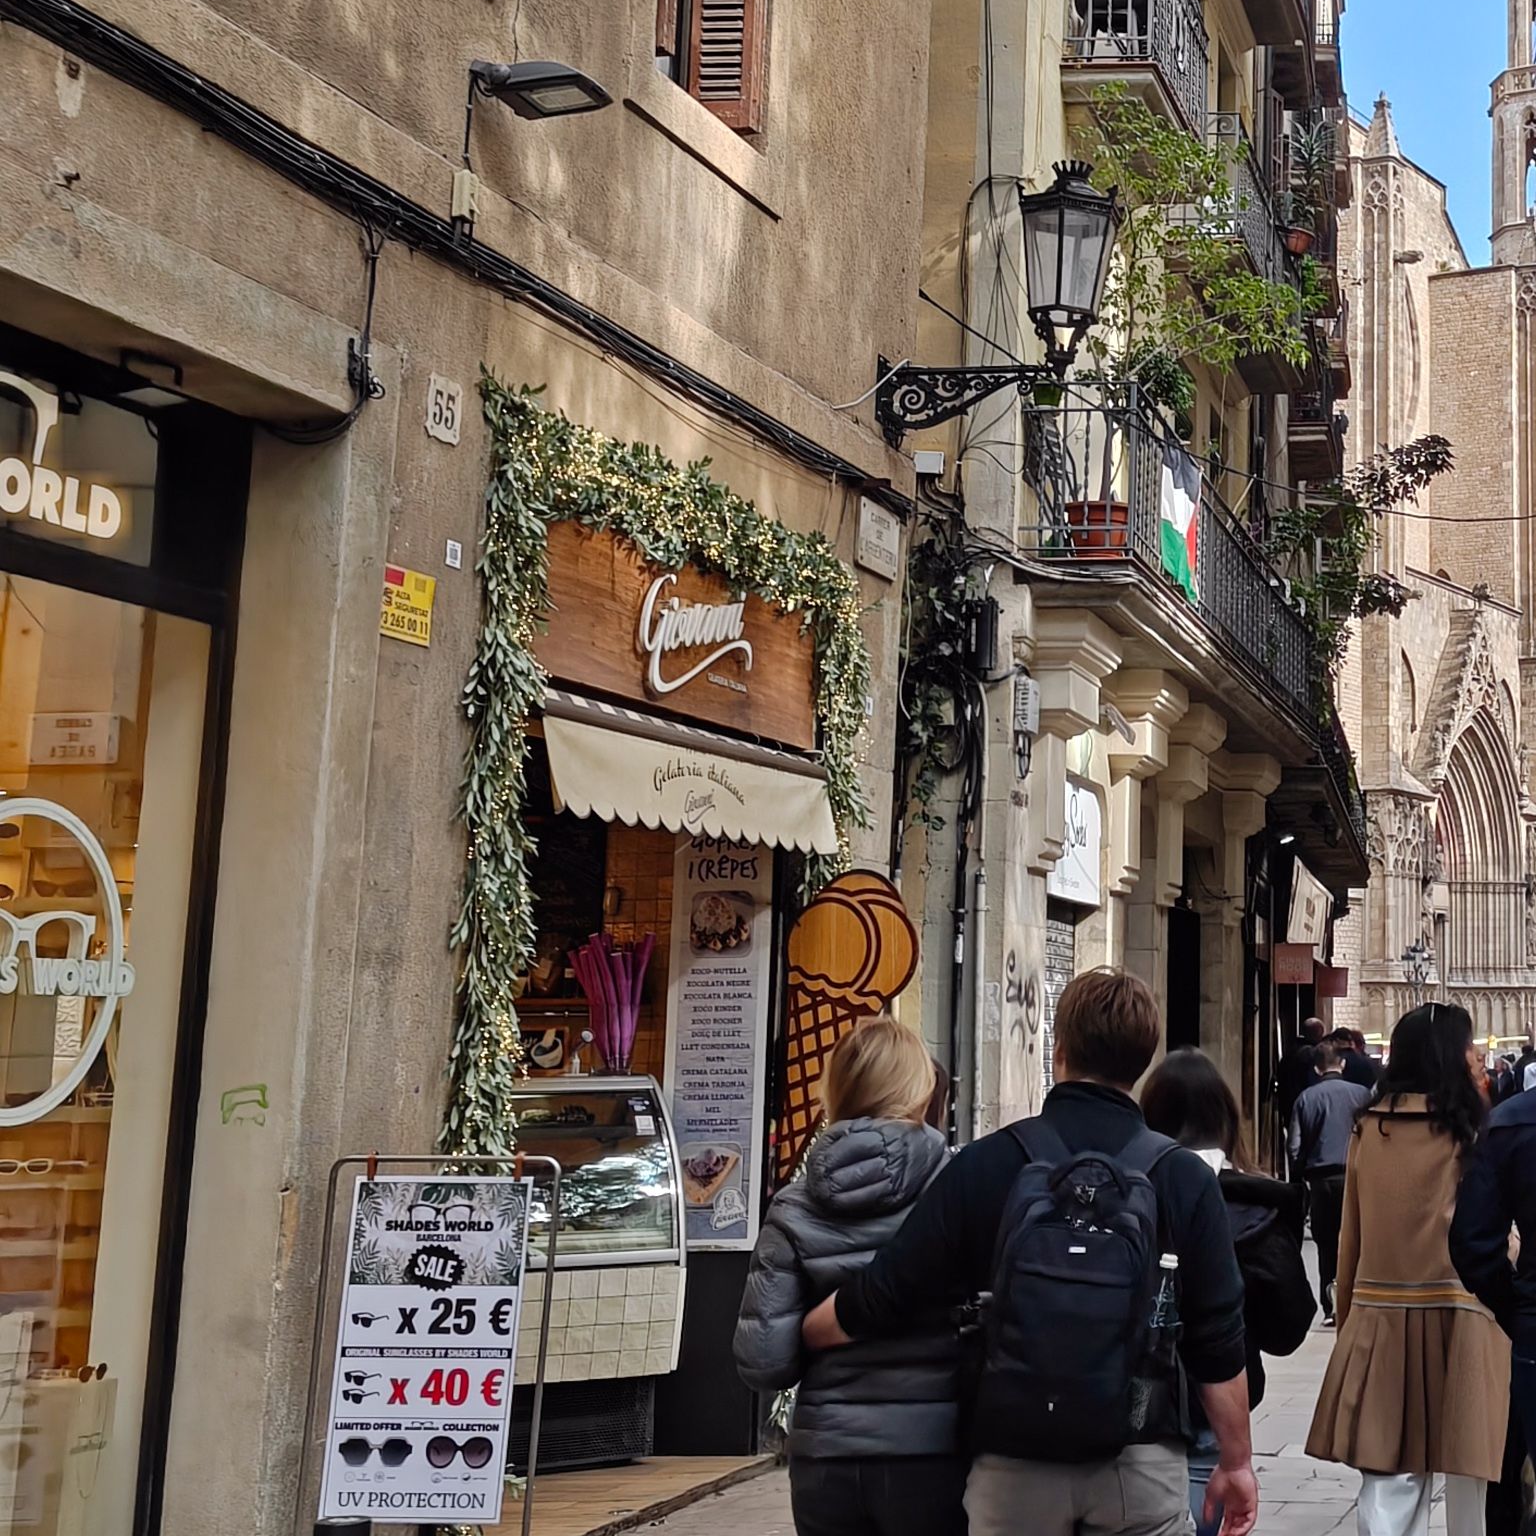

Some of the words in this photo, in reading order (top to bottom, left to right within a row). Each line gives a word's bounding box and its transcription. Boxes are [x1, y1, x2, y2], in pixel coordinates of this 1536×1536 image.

[433, 389, 456, 431] 55
[395, 590, 411, 601] ALTA
[390, 613, 406, 629] 265
[407, 618, 418, 633] 00
[420, 621, 429, 636] 11
[642, 573, 753, 693] Giovanni
[653, 757, 704, 797] Gelateria
[707, 762, 745, 806] italiana
[33, 958, 136, 996] WORLD
[385, 1220, 440, 1232] SHADES
[444, 1220, 494, 1232] WORLD
[416, 1233, 461, 1242] BARCELONA
[414, 1253, 458, 1282] SALE
[428, 1297, 477, 1335] 25
[488, 1298, 513, 1336] €
[345, 1348, 381, 1357] ORIGINAL
[383, 1348, 433, 1357] SUNGLASSES
[435, 1349, 445, 1357] BY
[447, 1349, 478, 1358] SHADES
[480, 1350, 508, 1358] WORLD
[420, 1368, 470, 1406] 40
[481, 1369, 505, 1406] €
[335, 1422, 371, 1431] LIMITED
[373, 1422, 402, 1431] OFFER
[443, 1423, 500, 1432] COLLECTION
[338, 1491, 367, 1507] UV
[367, 1492, 486, 1508] PROTECTION
